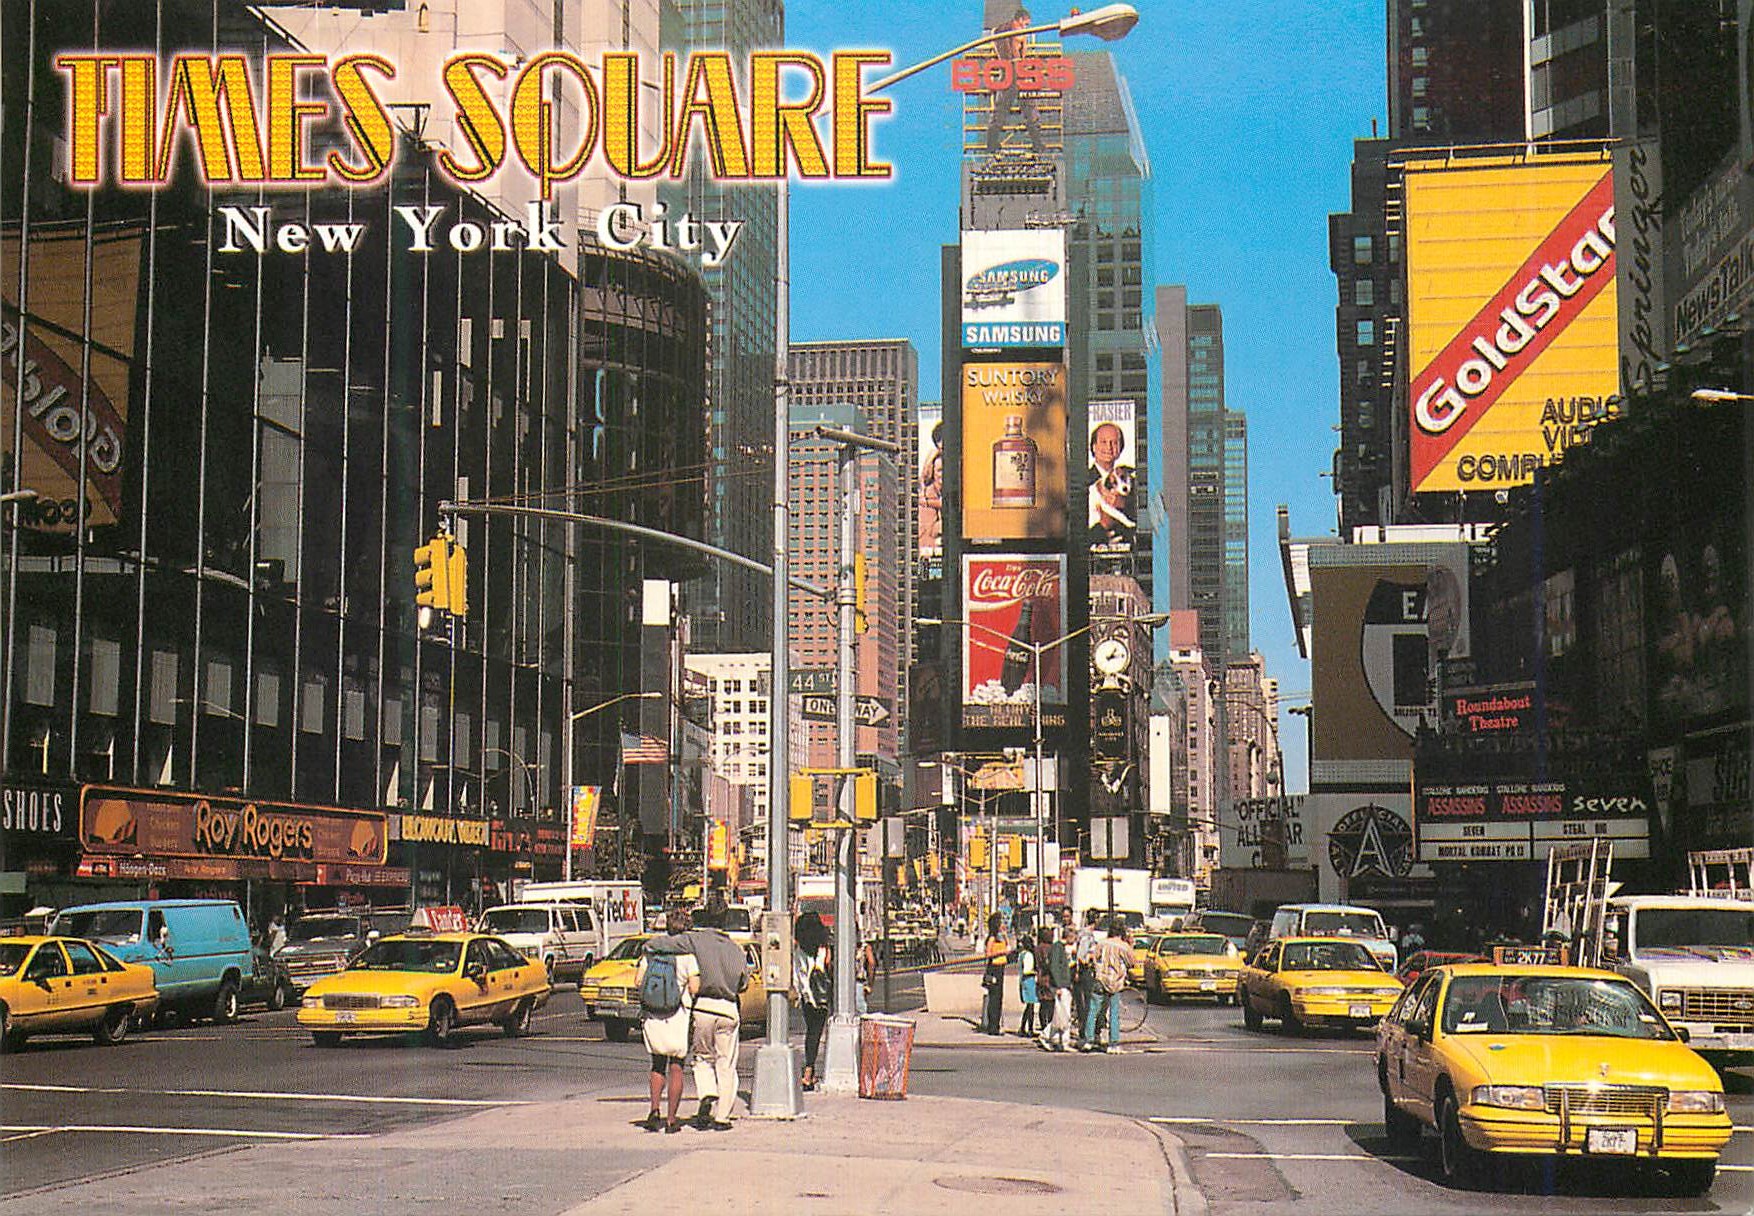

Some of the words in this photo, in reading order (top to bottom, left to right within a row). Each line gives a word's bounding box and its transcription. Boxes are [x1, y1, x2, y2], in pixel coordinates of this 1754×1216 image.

[952, 58, 1077, 91] BOSS
[966, 325, 1061, 344] SAMSUNG
[967, 368, 1058, 388] SUNTORY
[982, 389, 1044, 407] WHISKY
[792, 674, 815, 691] 44
[1456, 695, 1532, 717] Roundabout
[965, 715, 987, 727] THE
[1469, 714, 1519, 732] Theatre
[3, 789, 62, 832] SHOES
[1573, 795, 1647, 813] seven
[195, 800, 238, 850] Roy
[243, 803, 314, 858] Rogers
[1517, 950, 1546, 965] 2K77
